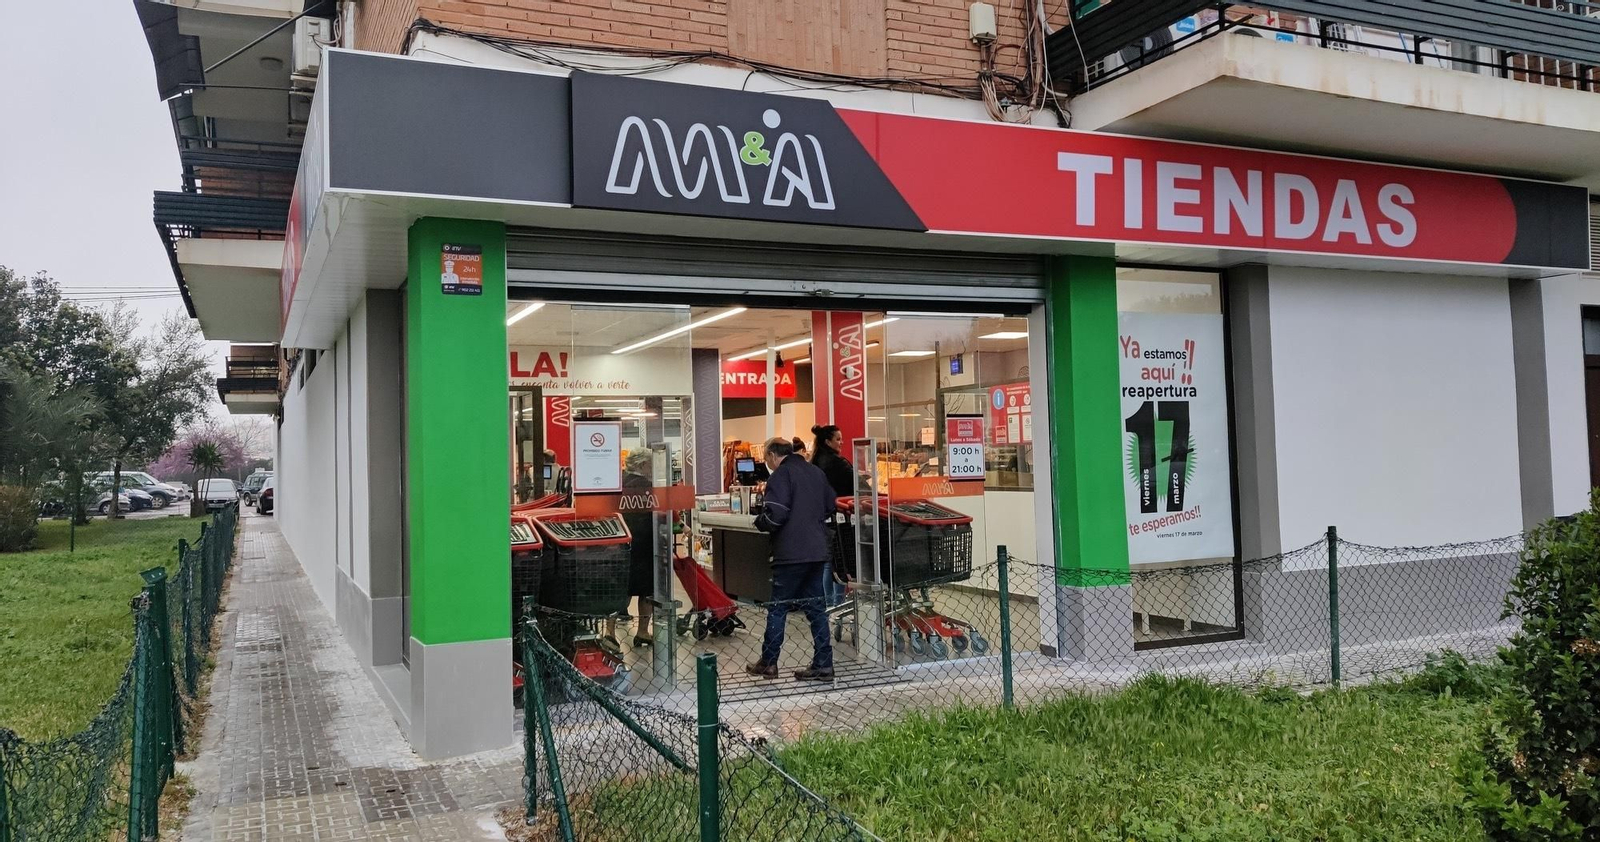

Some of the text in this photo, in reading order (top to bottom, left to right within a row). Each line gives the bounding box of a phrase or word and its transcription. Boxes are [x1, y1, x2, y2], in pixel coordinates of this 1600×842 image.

[1057, 151, 1417, 248] TIENDAS
[443, 253, 480, 262] SEGURIDAD
[1120, 335, 1187, 360] Ya estamos
[1141, 363, 1176, 383] aquí
[563, 379, 594, 389] volver
[608, 379, 630, 389] verte
[1122, 385, 1197, 400] reapertura
[953, 447, 972, 455] 9:00
[1125, 401, 1194, 513] 17
[952, 465, 974, 473] 21:00
[1129, 500, 1202, 536] te esperamos!!
